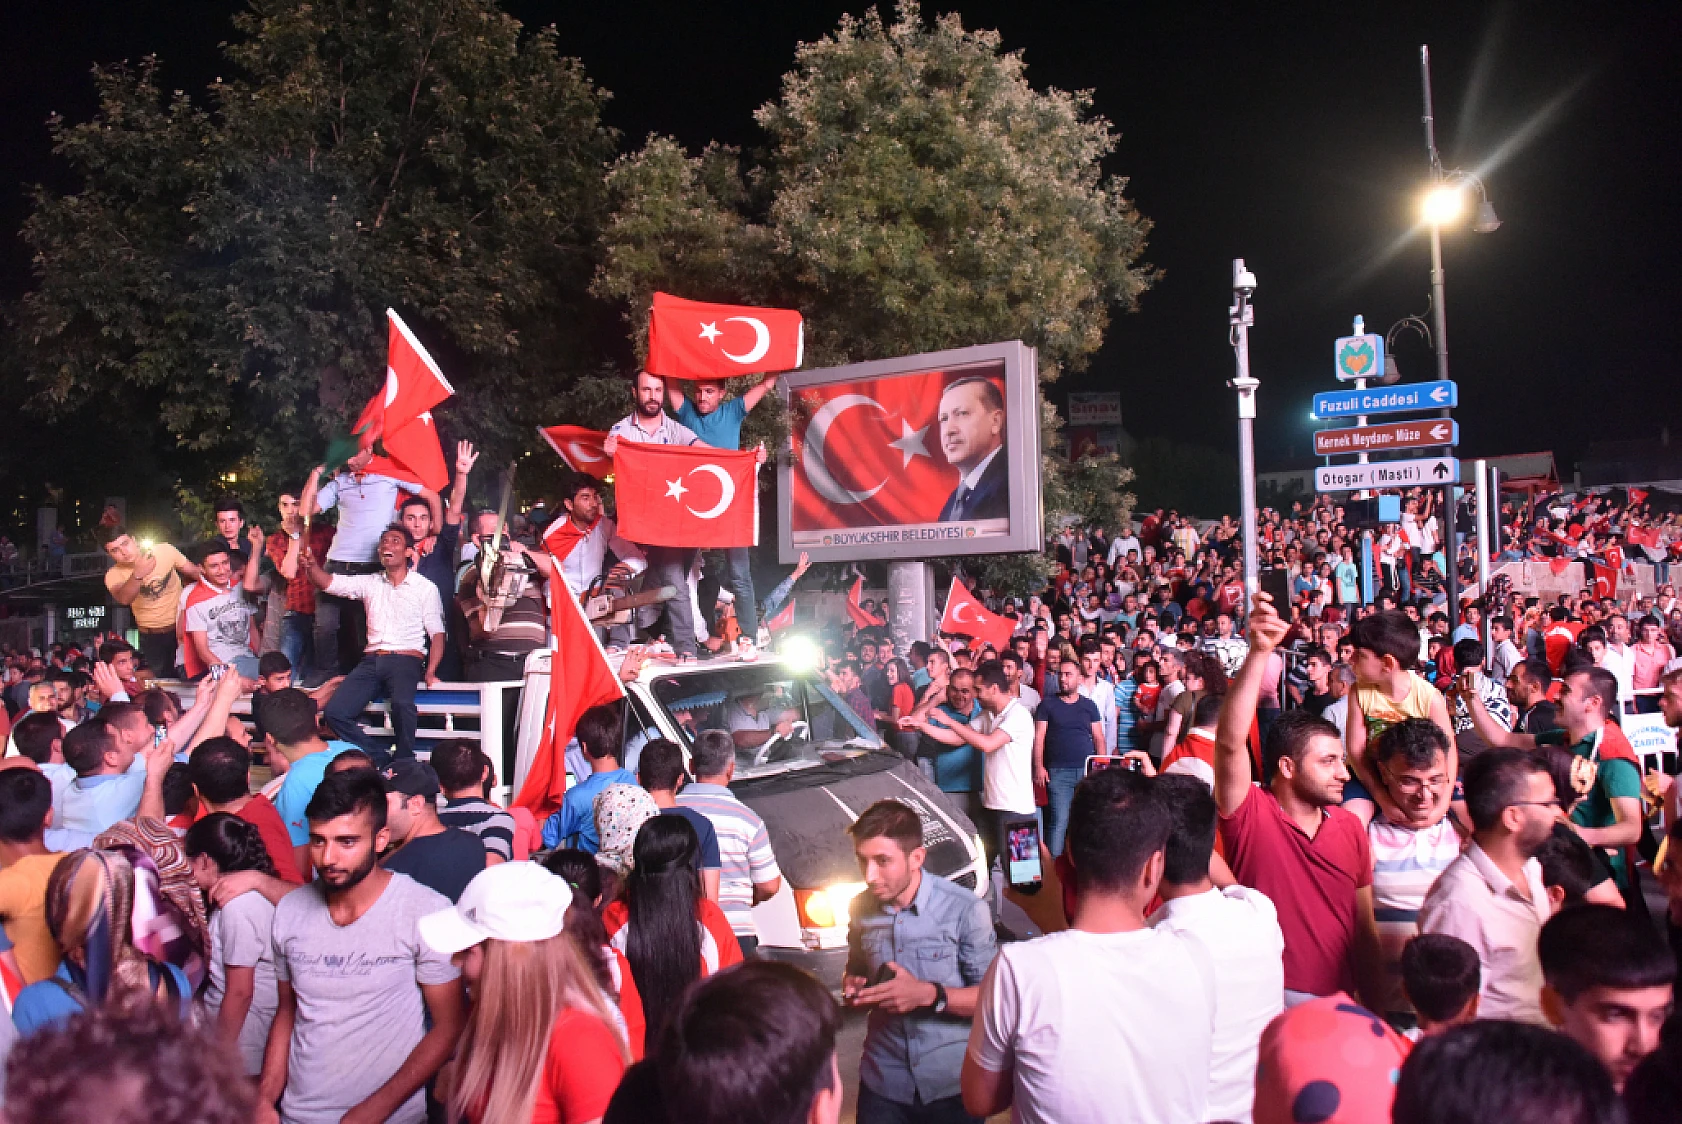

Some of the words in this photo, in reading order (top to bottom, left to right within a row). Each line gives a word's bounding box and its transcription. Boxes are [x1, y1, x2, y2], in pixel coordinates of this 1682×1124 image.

[1319, 397, 1359, 414] Fuzuli
[1363, 391, 1419, 409] Caddesi
[1317, 434, 1350, 450] Kernek
[1396, 428, 1421, 441] Müze
[1322, 471, 1364, 487] Otogar
